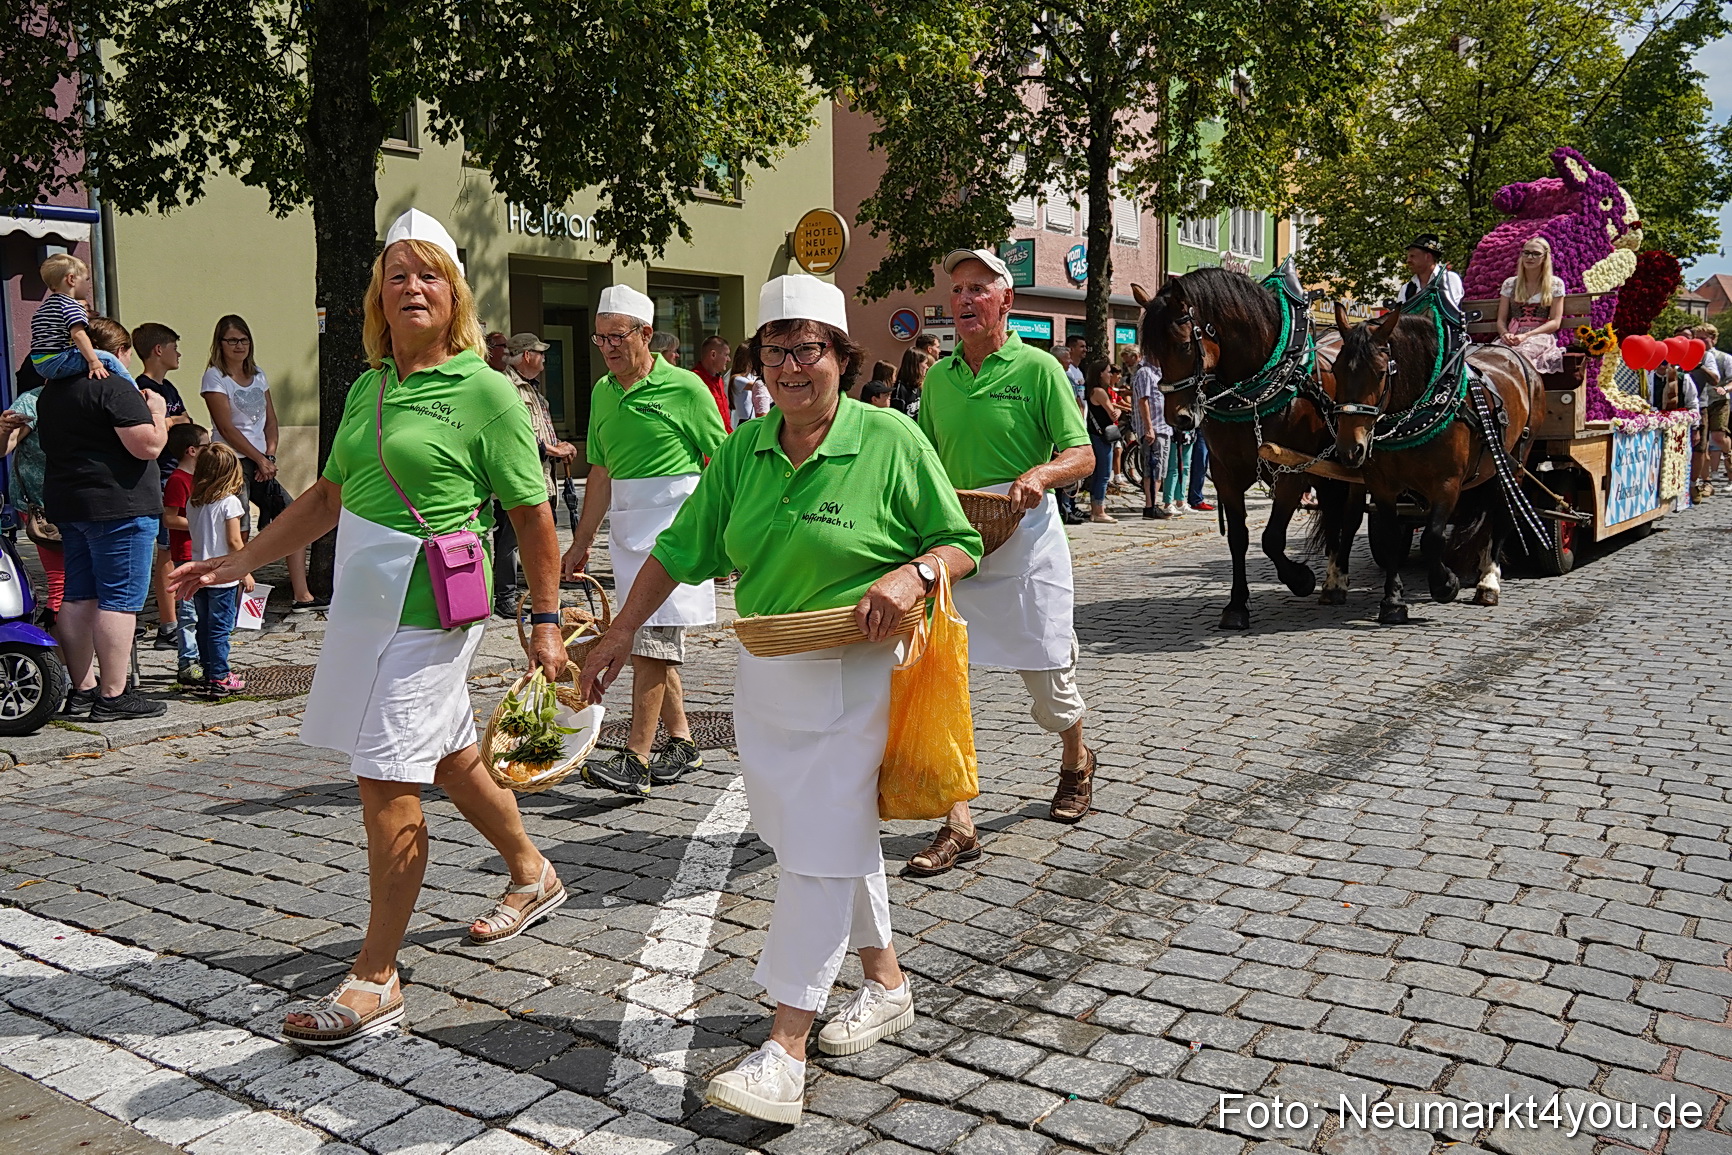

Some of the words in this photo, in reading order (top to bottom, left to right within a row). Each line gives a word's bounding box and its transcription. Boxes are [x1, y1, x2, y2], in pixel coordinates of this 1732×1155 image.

[805, 227, 839, 238] HOTEL
[805, 238, 826, 247] NEU
[805, 246, 839, 257] MARKT
[1003, 247, 1017, 258] vom
[1007, 250, 1029, 265] FASS
[1067, 248, 1081, 263] vom
[1071, 260, 1089, 278] FAS
[1004, 385, 1023, 394] OGV
[989, 391, 1023, 401] Woffenbach
[431, 400, 457, 415] OGV
[647, 401, 664, 410] OGV
[409, 403, 450, 424] Woffenbach
[819, 501, 844, 515] OGV
[801, 511, 841, 527] Woffenbach
[842, 519, 856, 531] e.V.
